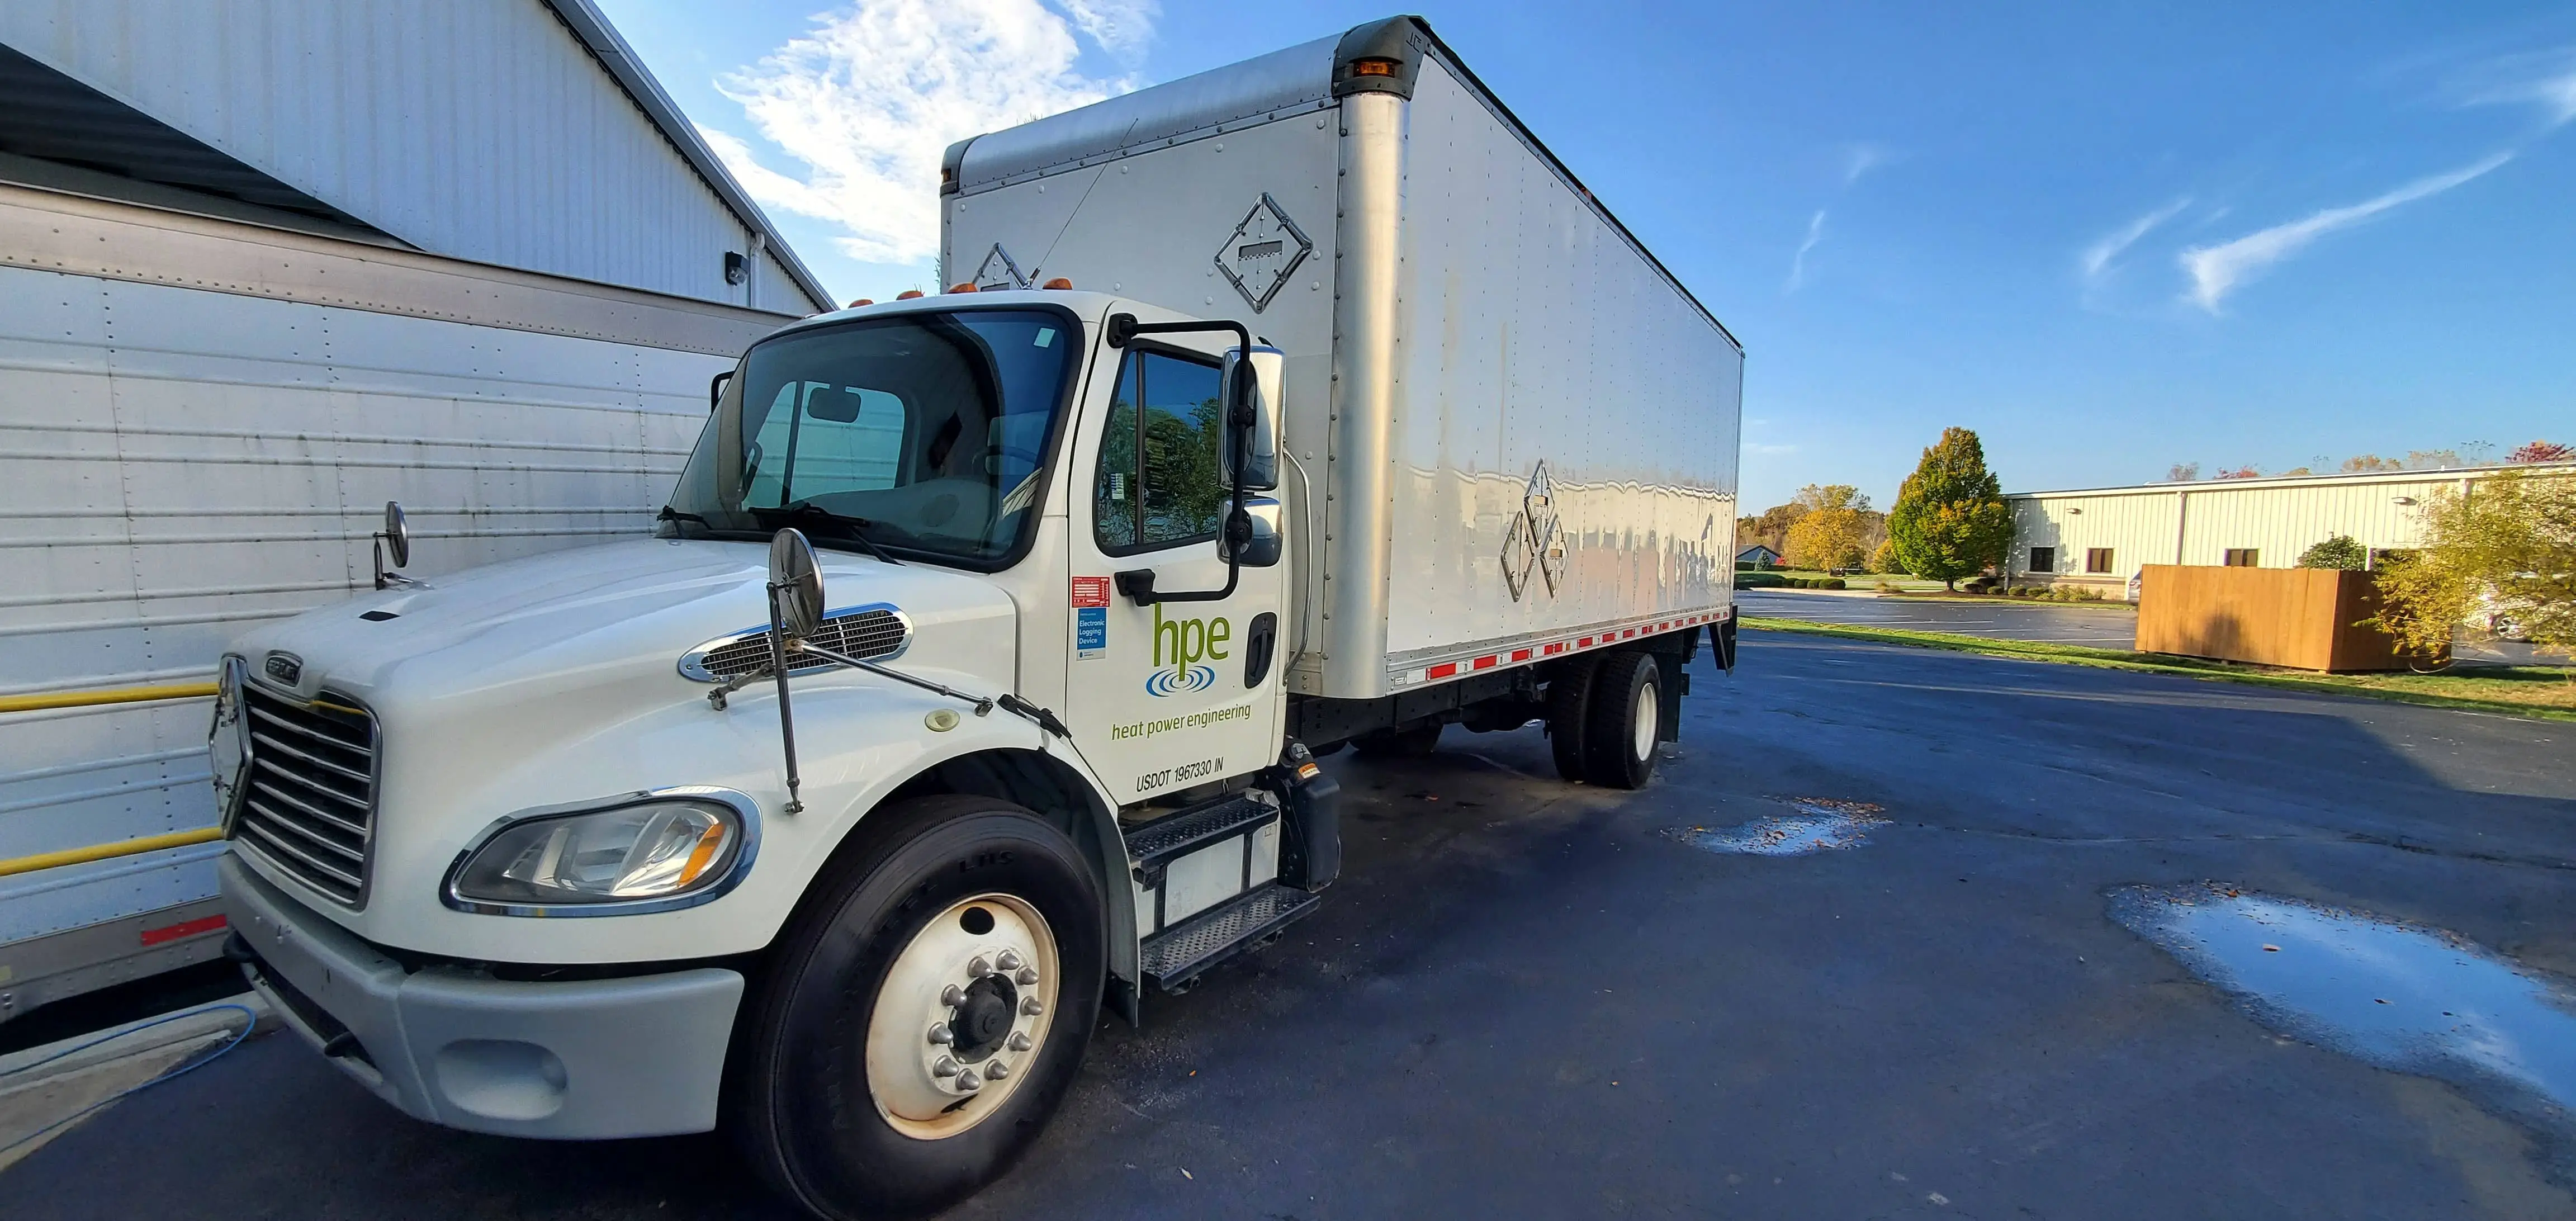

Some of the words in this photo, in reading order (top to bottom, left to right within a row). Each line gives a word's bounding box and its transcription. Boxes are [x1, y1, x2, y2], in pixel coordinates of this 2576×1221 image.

[1079, 628, 1101, 636] Logging
[1153, 602, 1230, 682] hpe
[1111, 721, 1143, 740] heat
[1147, 716, 1185, 739] power
[1187, 703, 1251, 728] engineering
[1137, 769, 1172, 792] USDOT
[1175, 759, 1211, 783] 1967330
[1214, 756, 1224, 772] IN
